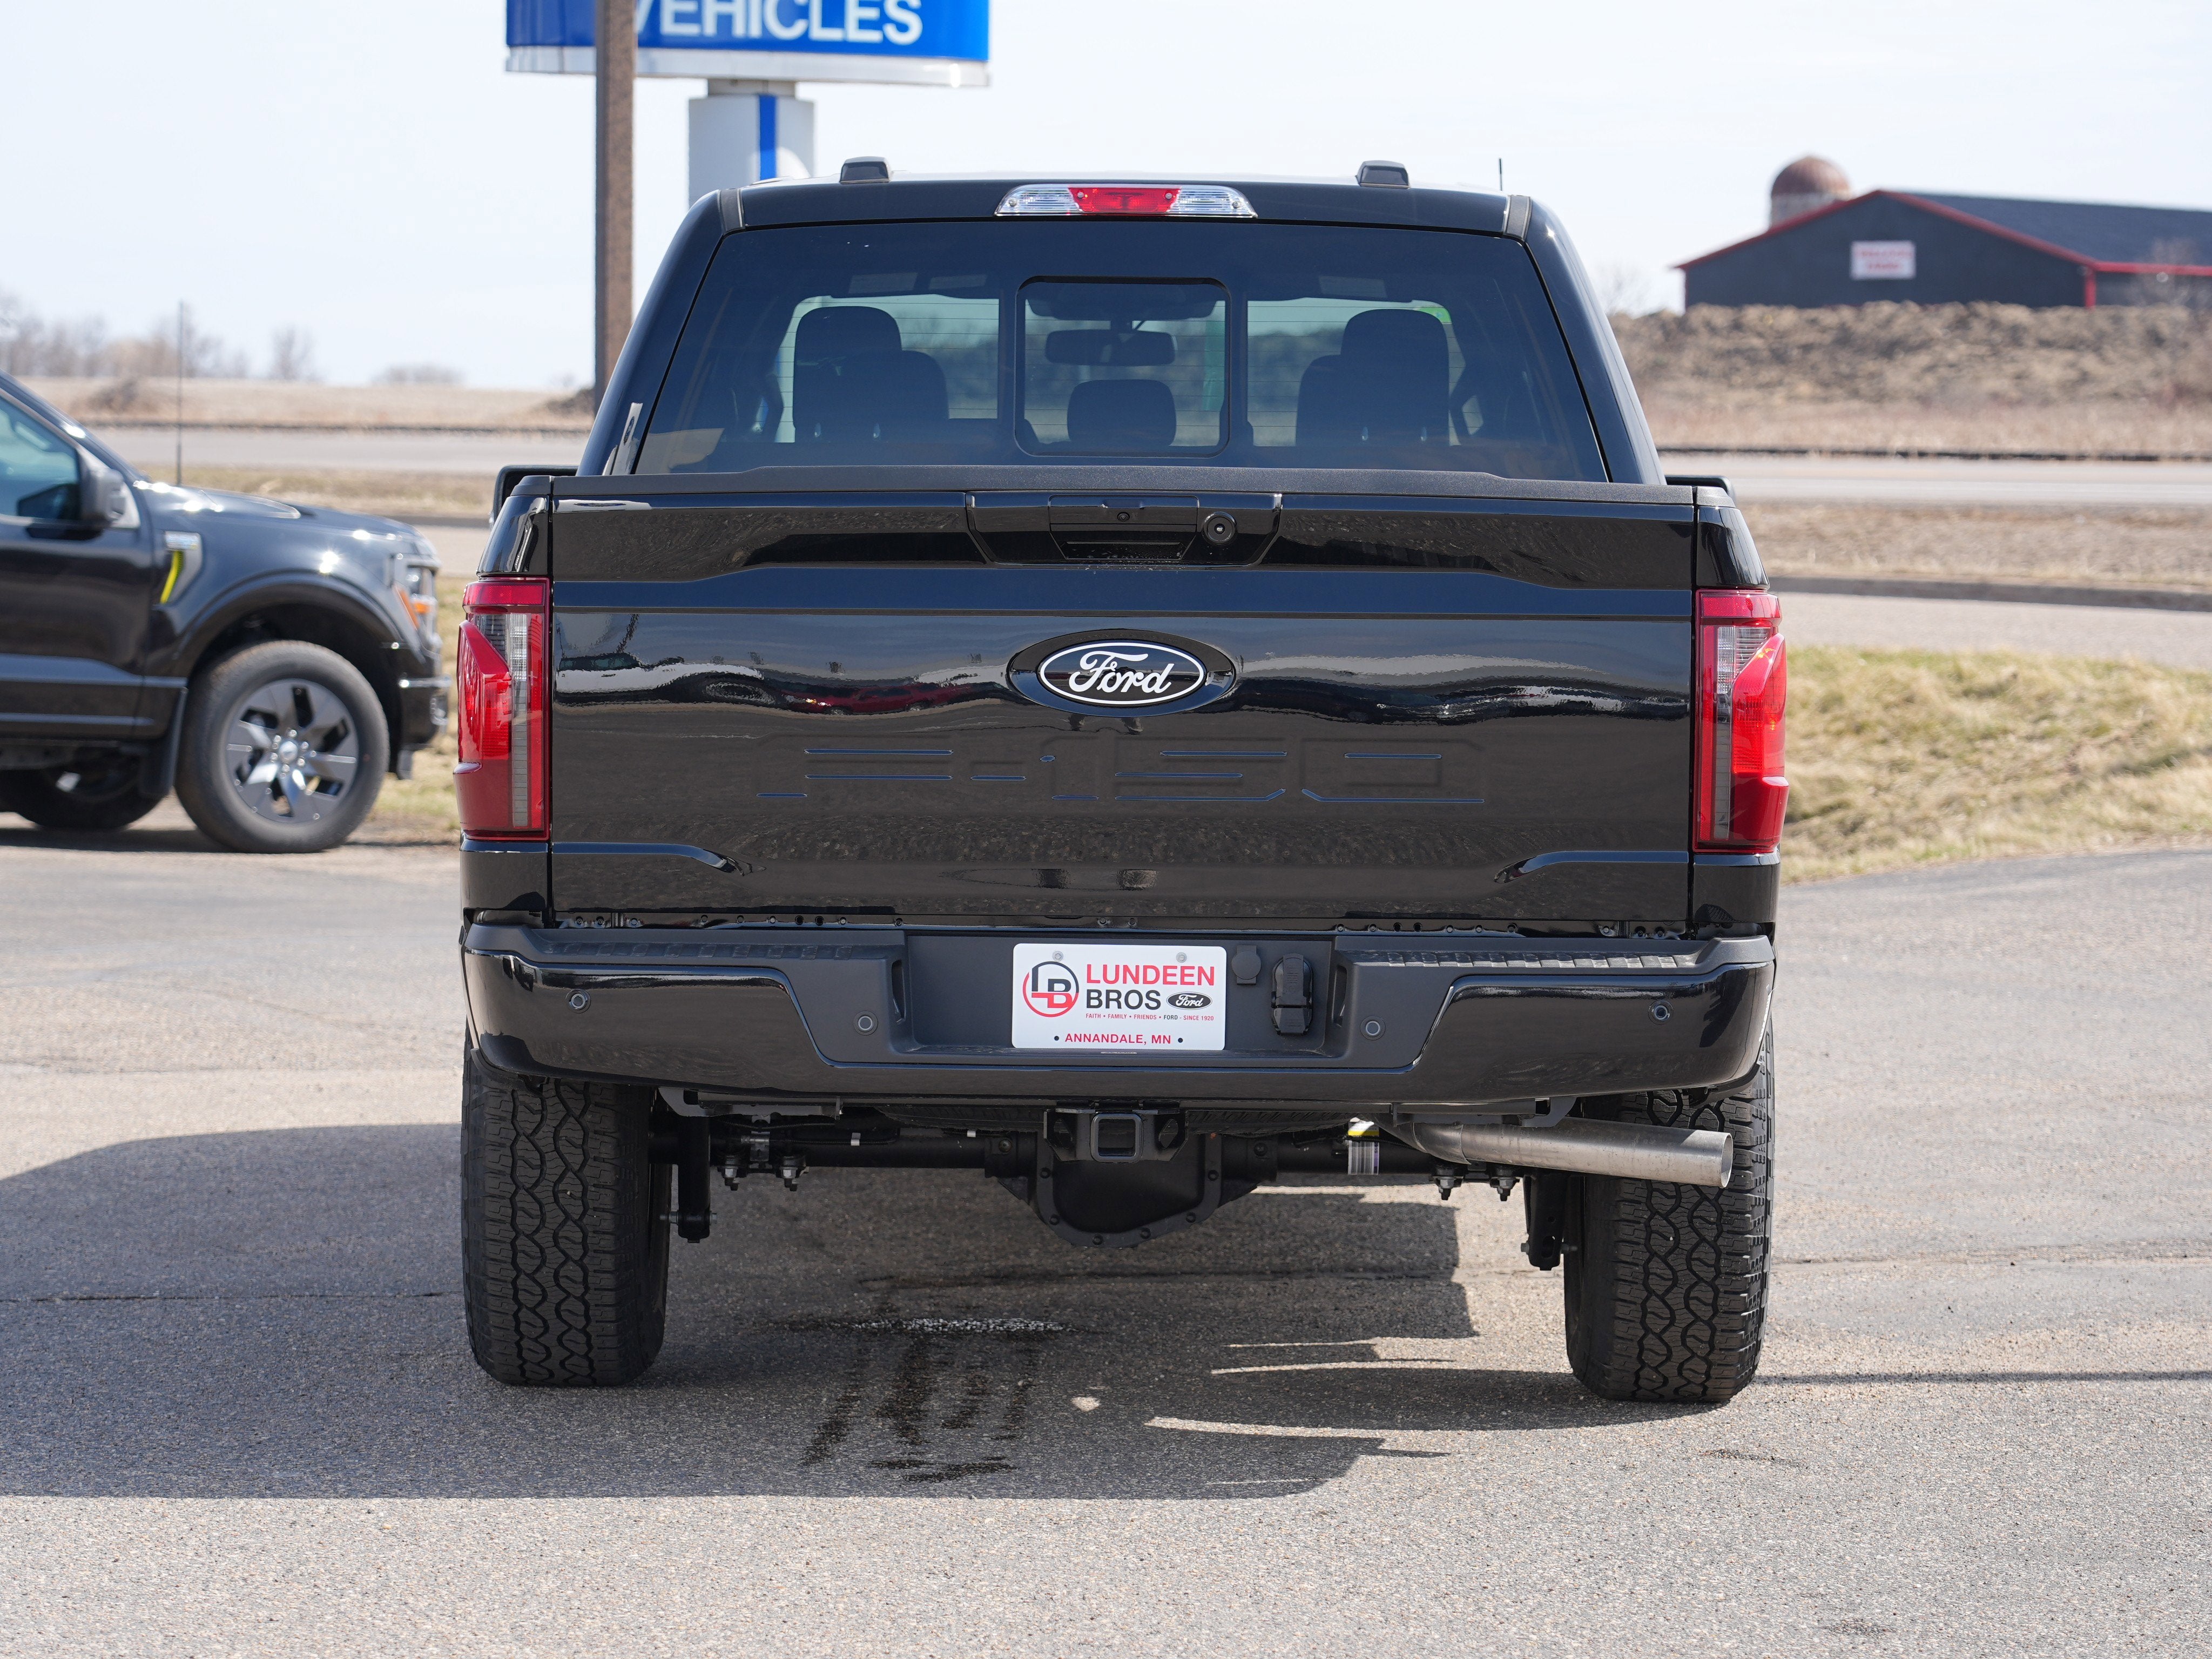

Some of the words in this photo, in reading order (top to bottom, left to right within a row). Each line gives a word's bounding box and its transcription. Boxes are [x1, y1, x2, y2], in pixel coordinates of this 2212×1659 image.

[1068, 650, 1175, 693] Ford
[757, 734, 1486, 802] F-150
[1087, 964, 1215, 986] LUNDEEN
[1087, 989, 1161, 1010] BROS
[1176, 994, 1204, 1006] Ford
[1064, 1033, 1147, 1046] ANNANDALE,
[1151, 1035, 1171, 1044] MN
